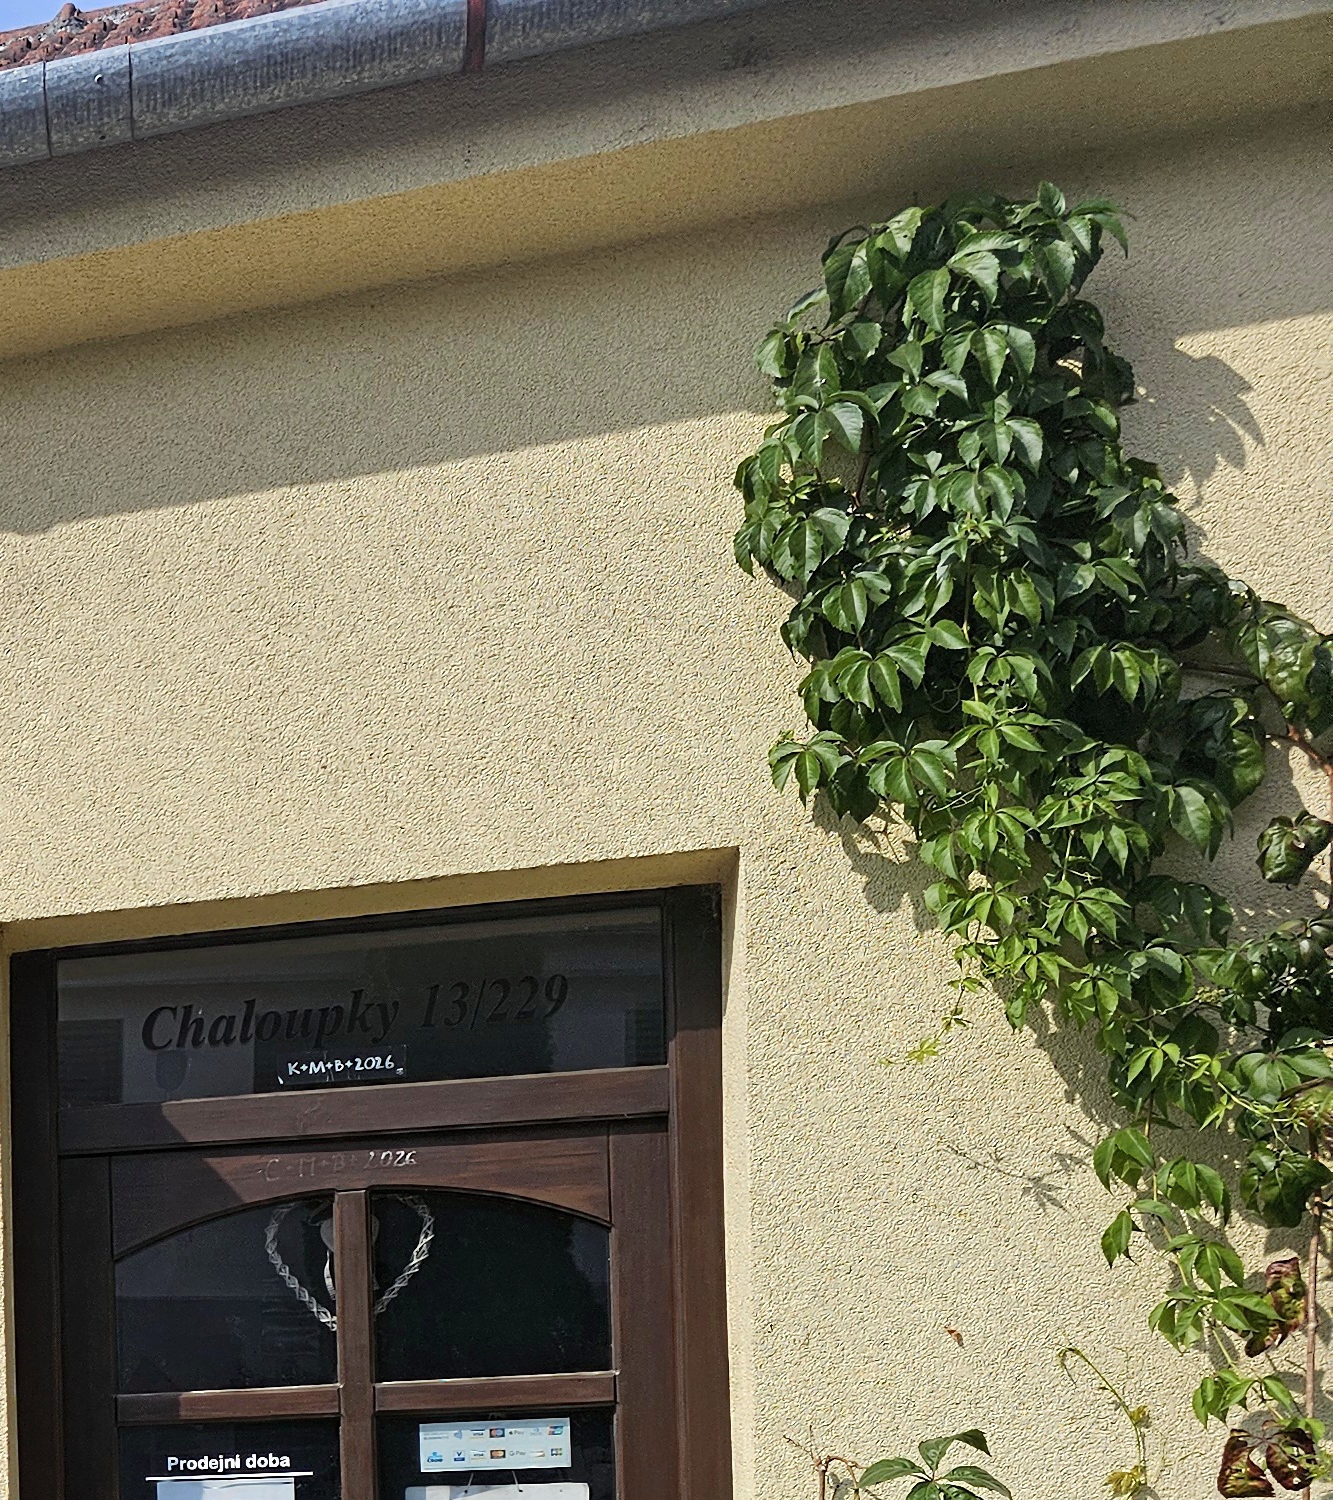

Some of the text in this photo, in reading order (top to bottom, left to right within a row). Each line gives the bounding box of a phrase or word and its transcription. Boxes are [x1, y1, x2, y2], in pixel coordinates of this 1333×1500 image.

[142, 974, 569, 1050] Chaloupky 13/229
[287, 1055, 395, 1077] K+M+B+2026
[167, 1453, 290, 1472] Prodejní doba
